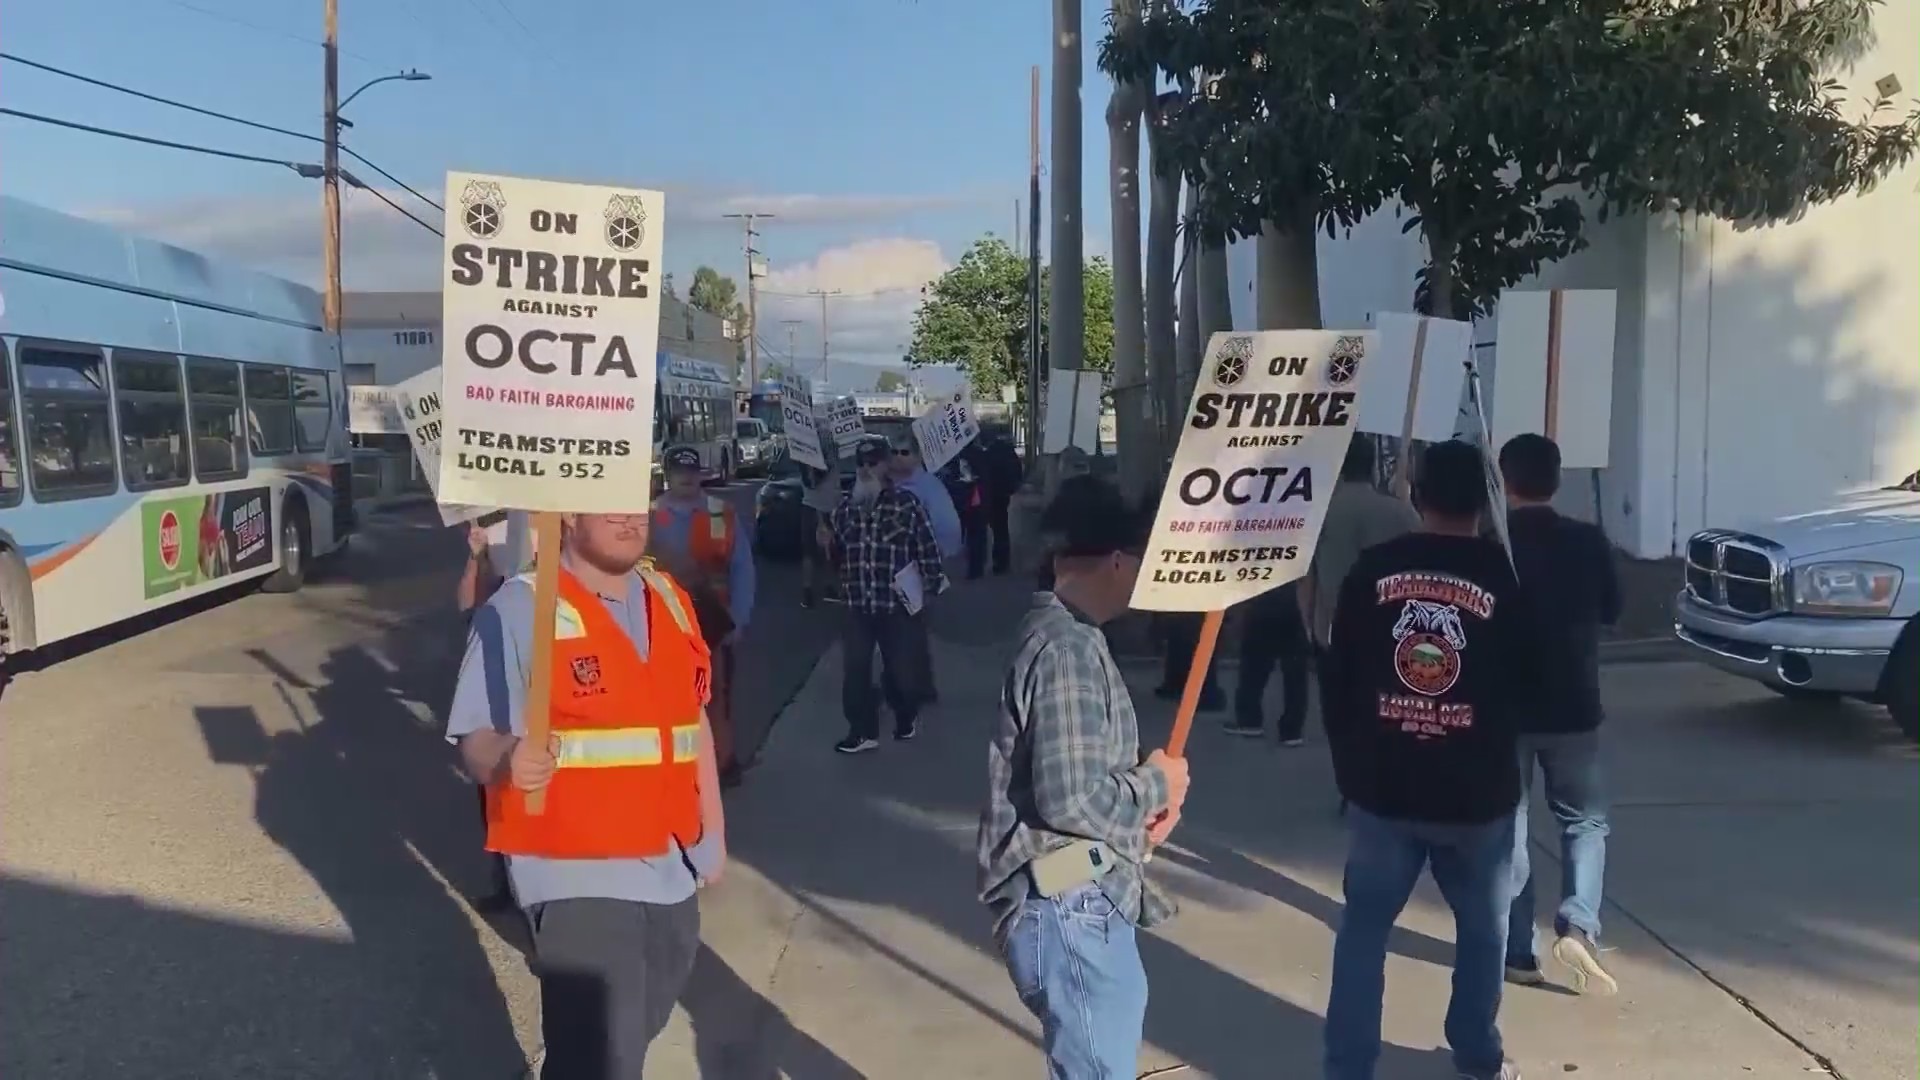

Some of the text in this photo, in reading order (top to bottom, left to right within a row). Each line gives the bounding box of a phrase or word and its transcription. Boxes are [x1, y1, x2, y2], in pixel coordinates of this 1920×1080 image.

[529, 209, 578, 235] ON
[451, 243, 650, 298] STRIKE
[503, 299, 598, 318] AGAINST
[465, 323, 638, 378] OCTA
[1268, 356, 1308, 376] ON
[466, 385, 635, 411] BAD FAITH BARGAINING
[784, 407, 813, 430] OCTA
[1191, 391, 1356, 430] STRIKE
[834, 421, 862, 435] OCTA
[459, 428, 631, 457] TEAMSTERS
[1227, 435, 1304, 448] AGAINST
[457, 453, 605, 480] LOCAL 952
[1179, 466, 1313, 507] OCTA
[1170, 516, 1305, 533] BAD FAITH BARGAINING
[1160, 545, 1299, 564] TEAMSTERS
[1152, 567, 1274, 584] LOCAL 952
